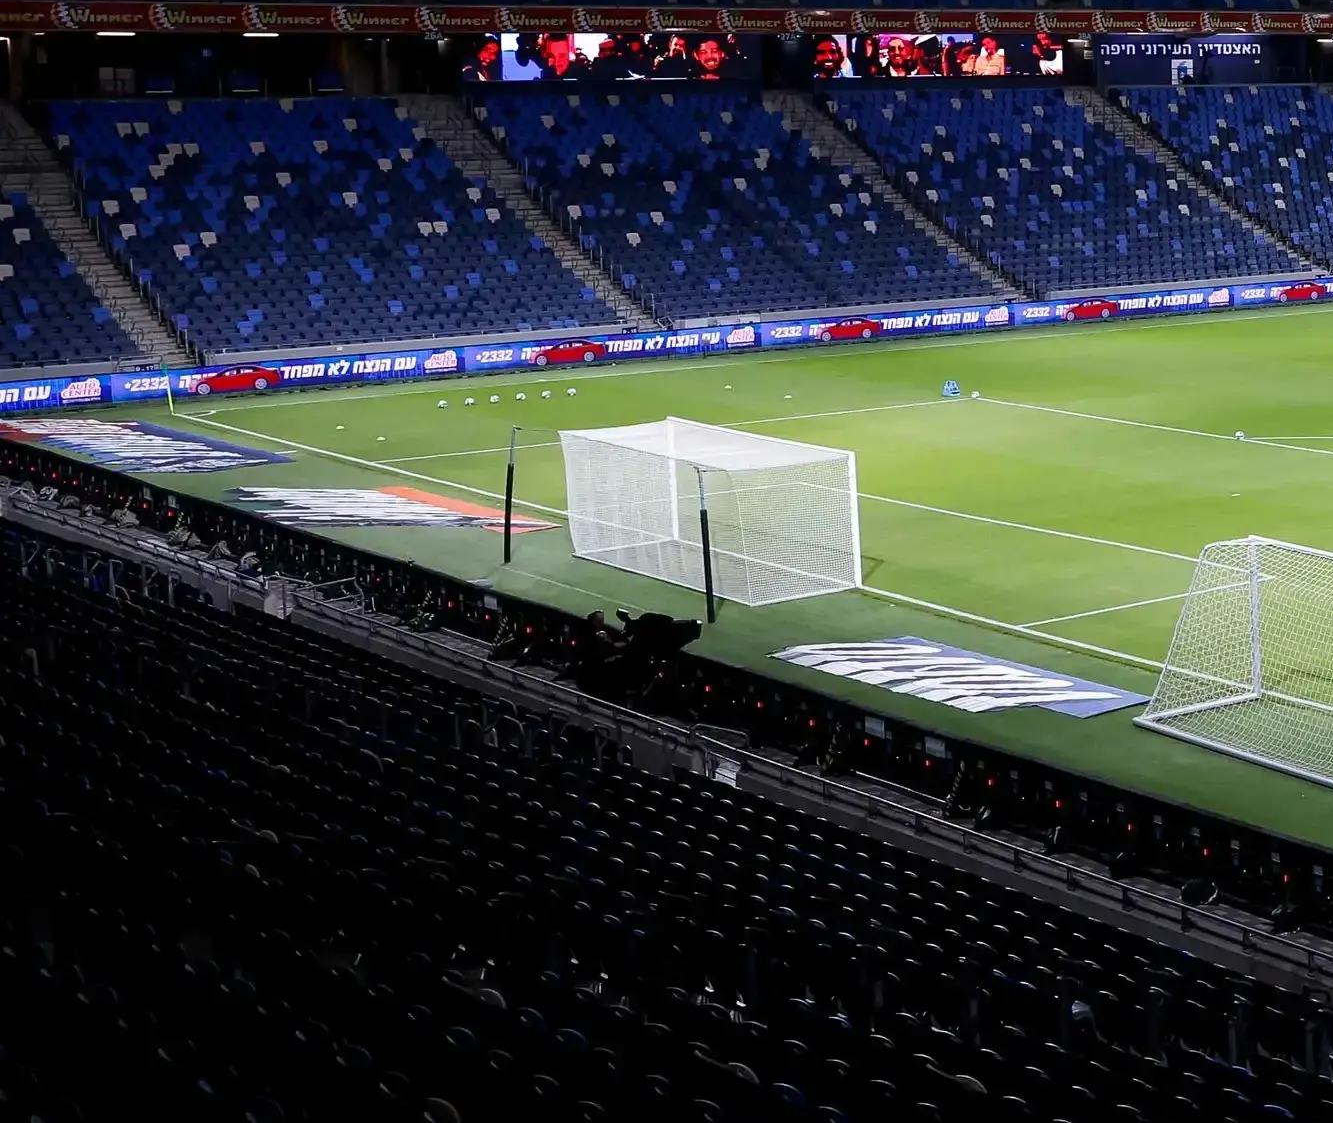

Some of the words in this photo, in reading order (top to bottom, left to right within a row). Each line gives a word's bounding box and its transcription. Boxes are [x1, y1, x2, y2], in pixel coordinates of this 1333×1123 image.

[0, 11, 44, 22] nner
[1100, 44, 1136, 55] חיפה
[1141, 43, 1192, 55] העירוני
[1118, 298, 1146, 310] מפחד
[1148, 297, 1161, 308] לא
[1163, 295, 1187, 307] הנצח
[1189, 292, 1204, 305] עם
[881, 316, 912, 330] מפחד
[915, 315, 931, 328] לא
[932, 313, 960, 326] הנצח
[963, 310, 979, 324] עם
[605, 339, 642, 354] מפחד
[645, 337, 662, 351] לא
[665, 335, 699, 348] הנצח
[395, 356, 416, 371] עם
[432, 353, 454, 361] AUTO
[281, 361, 324, 379] מפחד
[328, 360, 350, 375] לא
[353, 359, 391, 374] הנצח
[425, 360, 456, 368] CENTER
[62, 388, 101, 398] CENTER
[68, 382, 96, 391] AUTO
[24, 386, 51, 401] עם
